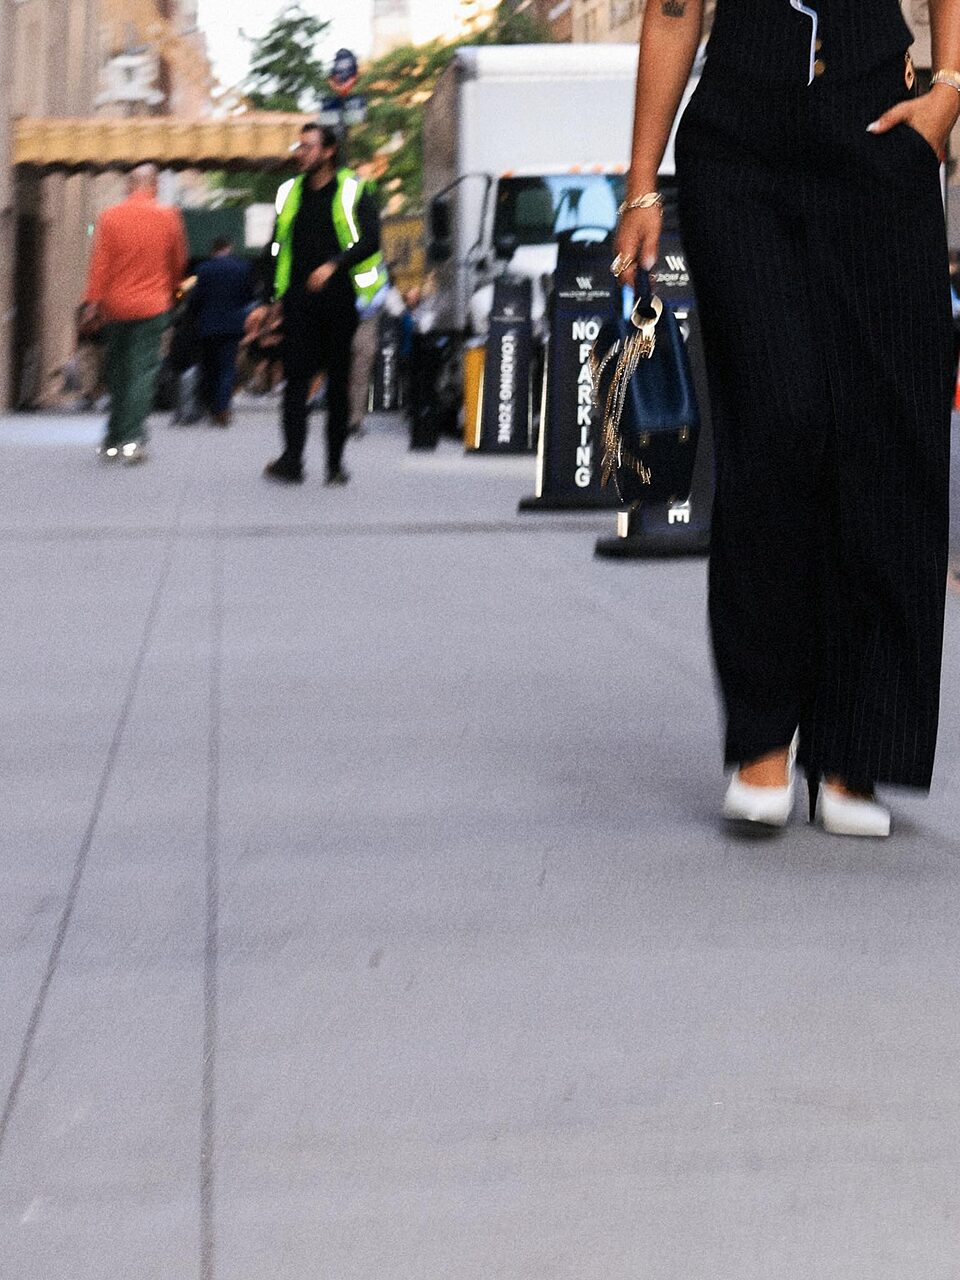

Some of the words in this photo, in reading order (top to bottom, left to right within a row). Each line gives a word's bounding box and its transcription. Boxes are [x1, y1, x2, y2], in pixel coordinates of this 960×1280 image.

[572, 321, 600, 341] NO
[499, 335, 514, 400] LOADING
[497, 403, 512, 443] ZONE
[574, 343, 592, 488] PARKING
